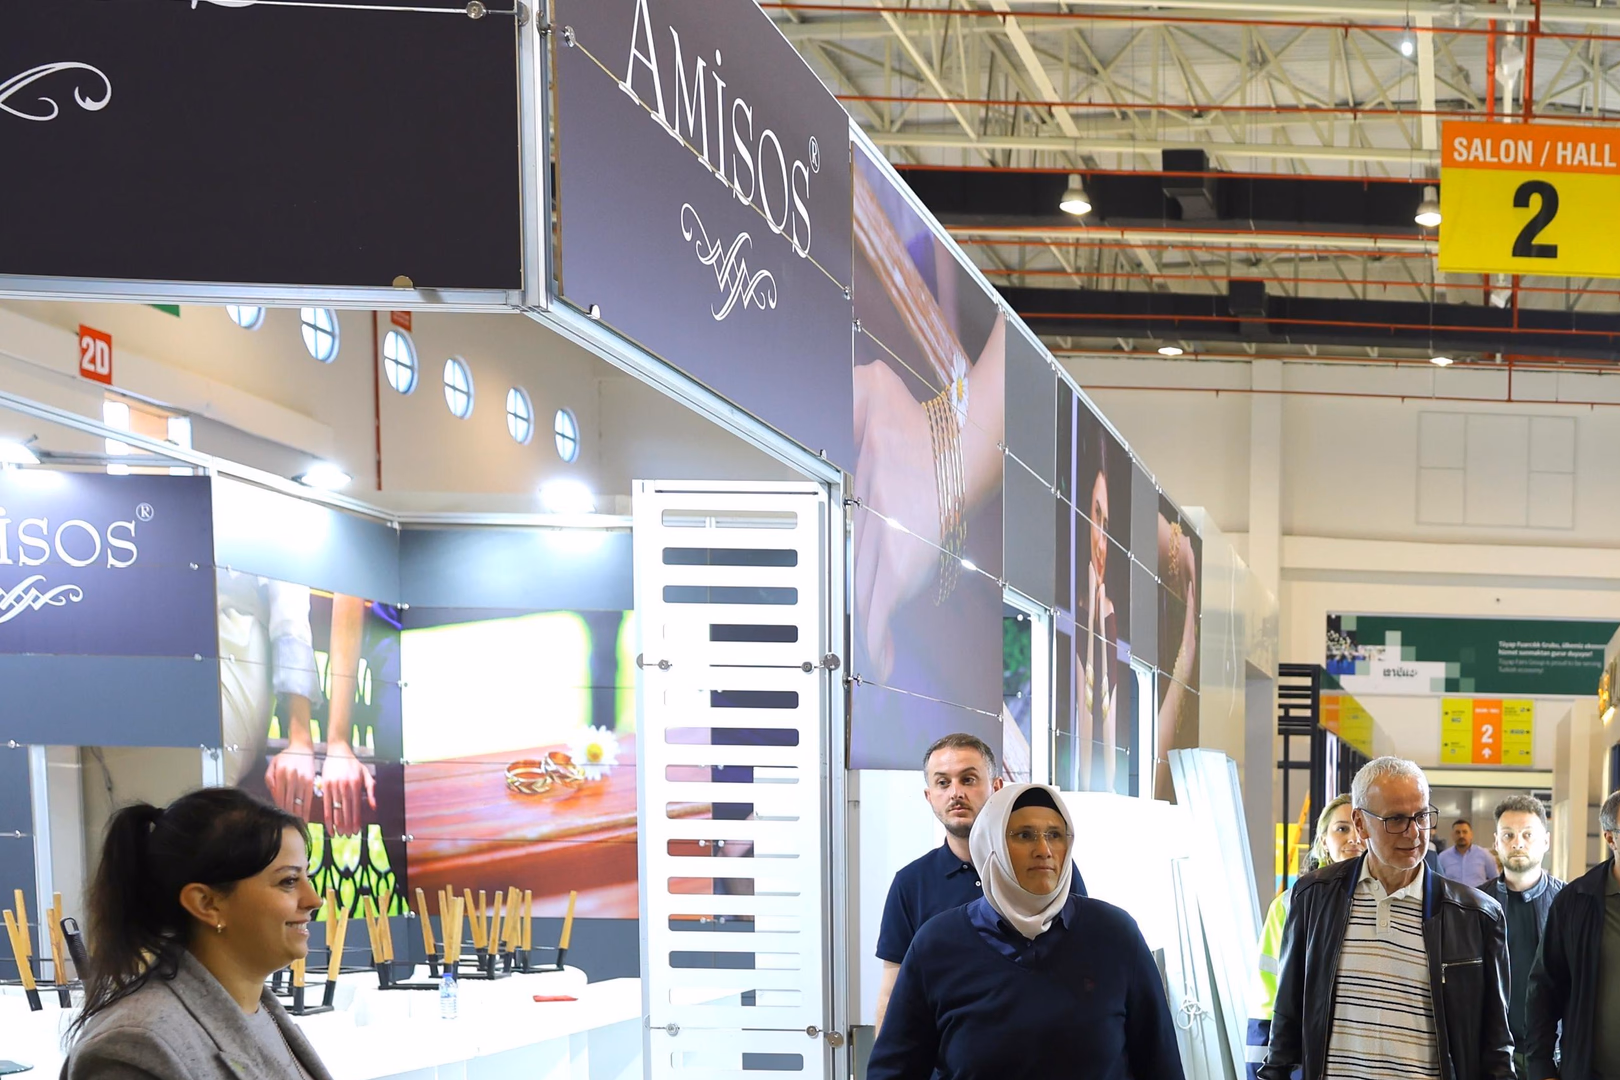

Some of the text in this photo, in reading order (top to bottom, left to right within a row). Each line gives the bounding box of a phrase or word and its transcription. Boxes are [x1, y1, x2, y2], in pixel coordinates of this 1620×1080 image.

[1453, 137, 1617, 168] SALON / HALL
[1512, 179, 1559, 259] 2
[81, 335, 110, 376] 2D
[1481, 724, 1494, 744] 2
